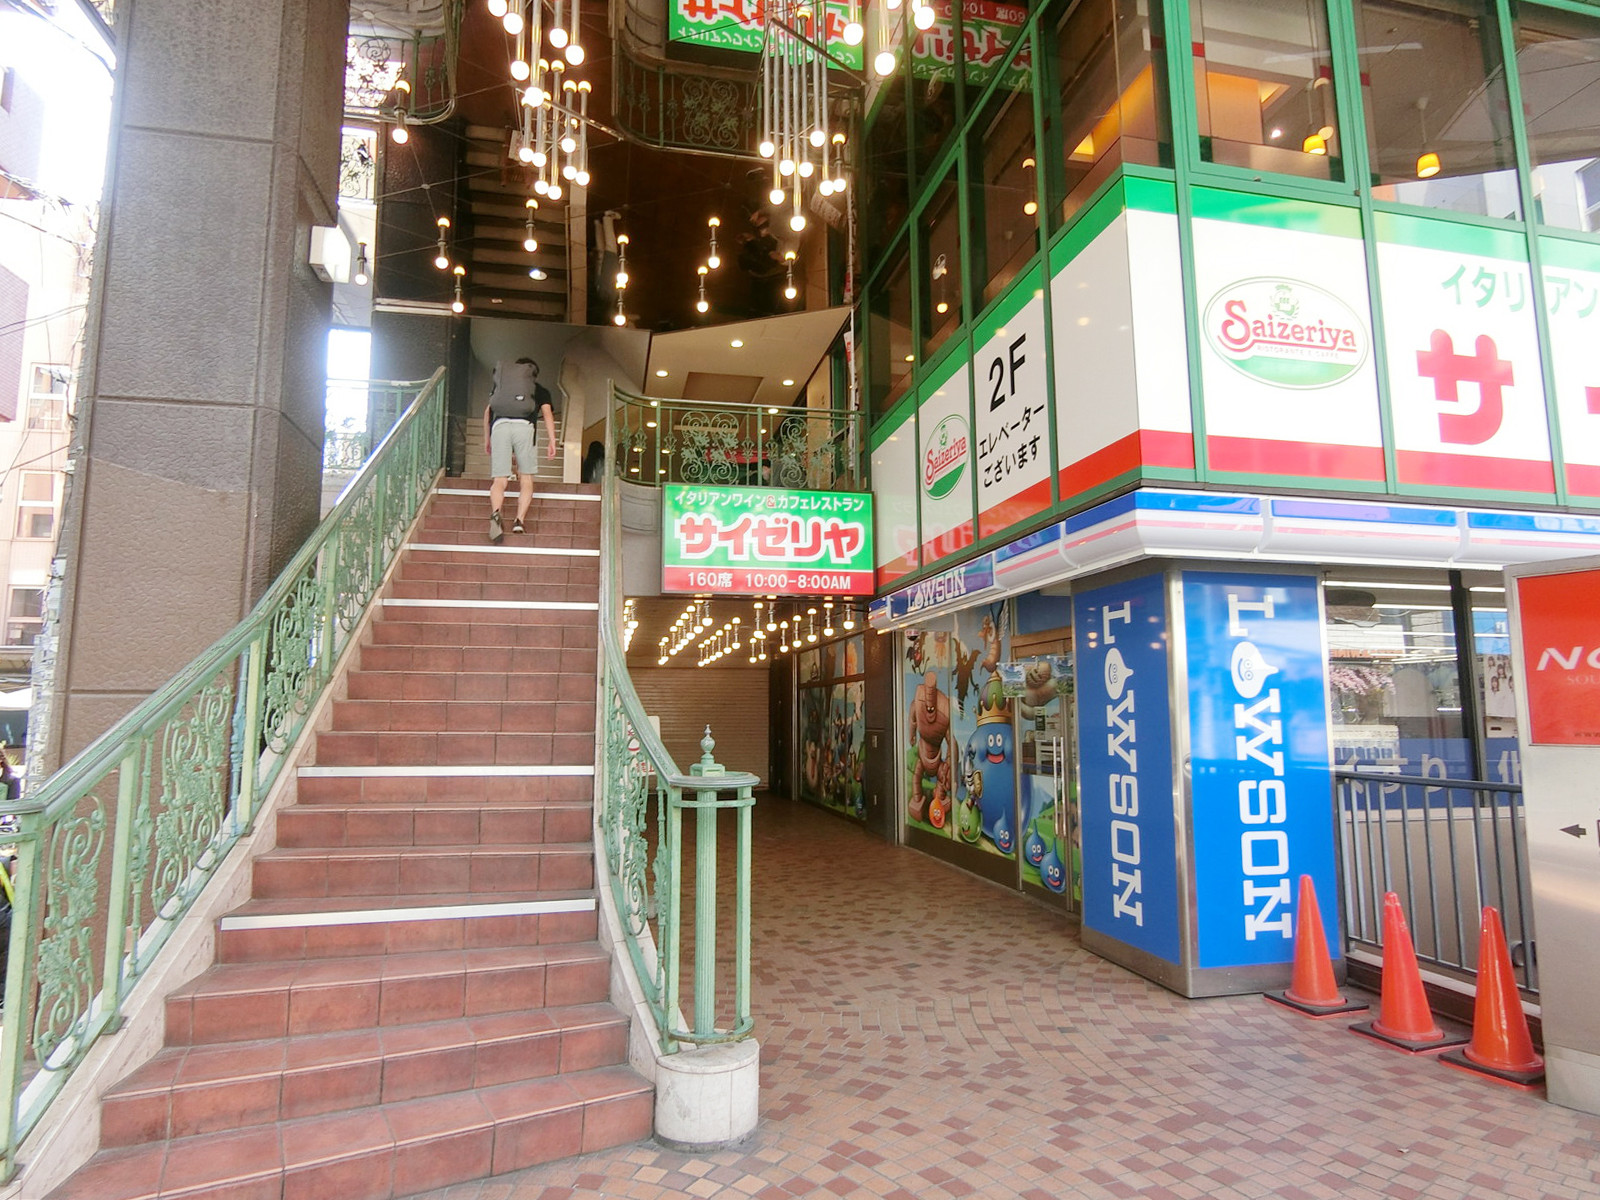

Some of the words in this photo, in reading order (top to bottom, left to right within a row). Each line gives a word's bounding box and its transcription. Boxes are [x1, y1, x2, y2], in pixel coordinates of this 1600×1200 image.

[1441, 264, 1598, 318] イタリアン
[1221, 300, 1356, 350] Saizeriya
[989, 333, 1026, 412] 2F
[979, 404, 1044, 459] エレベーター
[925, 436, 967, 482] Saizeriya
[984, 434, 1041, 488] ございます
[675, 490, 864, 511] イタリアンワイン&カフェレストラン
[678, 515, 861, 560] サイゼリヤ
[688, 572, 733, 588] 160席
[745, 574, 851, 590] 10:00-8:00AM
